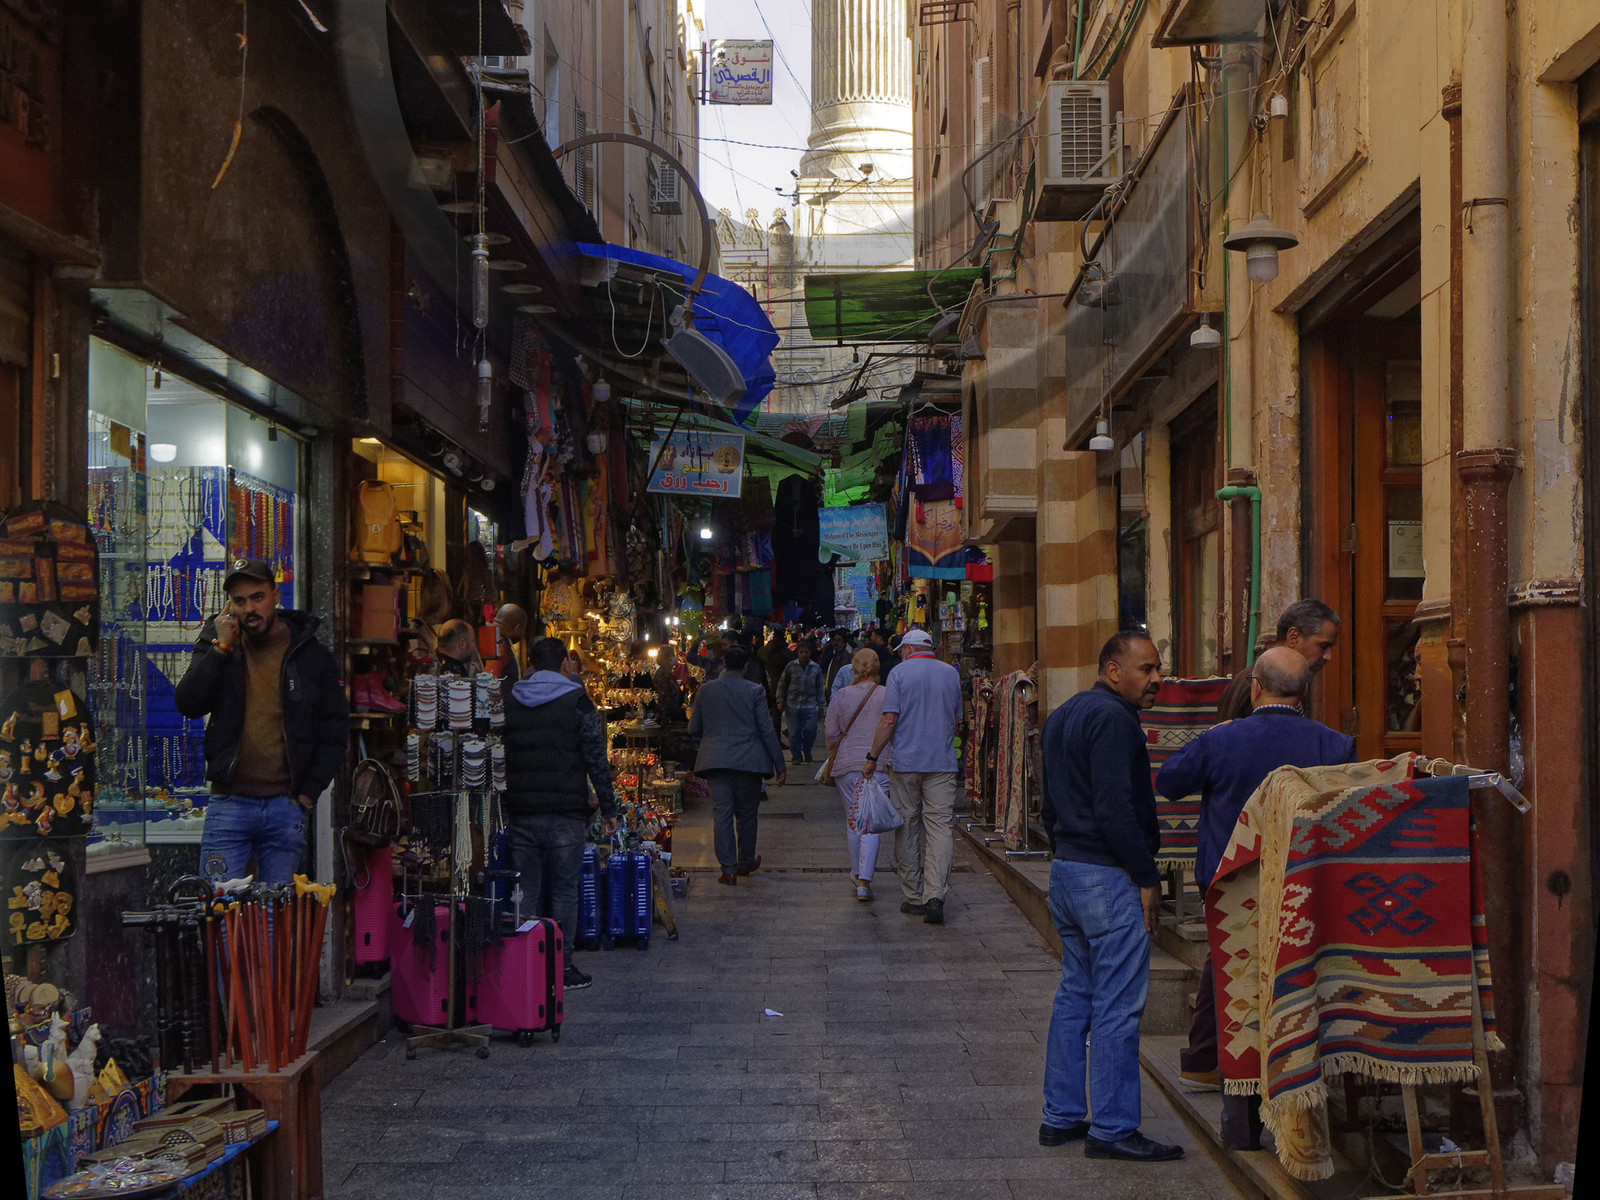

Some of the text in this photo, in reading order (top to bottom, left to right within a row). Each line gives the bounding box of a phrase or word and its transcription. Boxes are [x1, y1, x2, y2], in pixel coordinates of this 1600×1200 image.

[680, 445, 714, 460] بازار
[682, 461, 709, 474] الحاج
[660, 473, 728, 492] رجب رزق
[824, 532, 845, 540] Mohamed
[855, 531, 879, 539] Messenger
[860, 542, 872, 550] Upon
